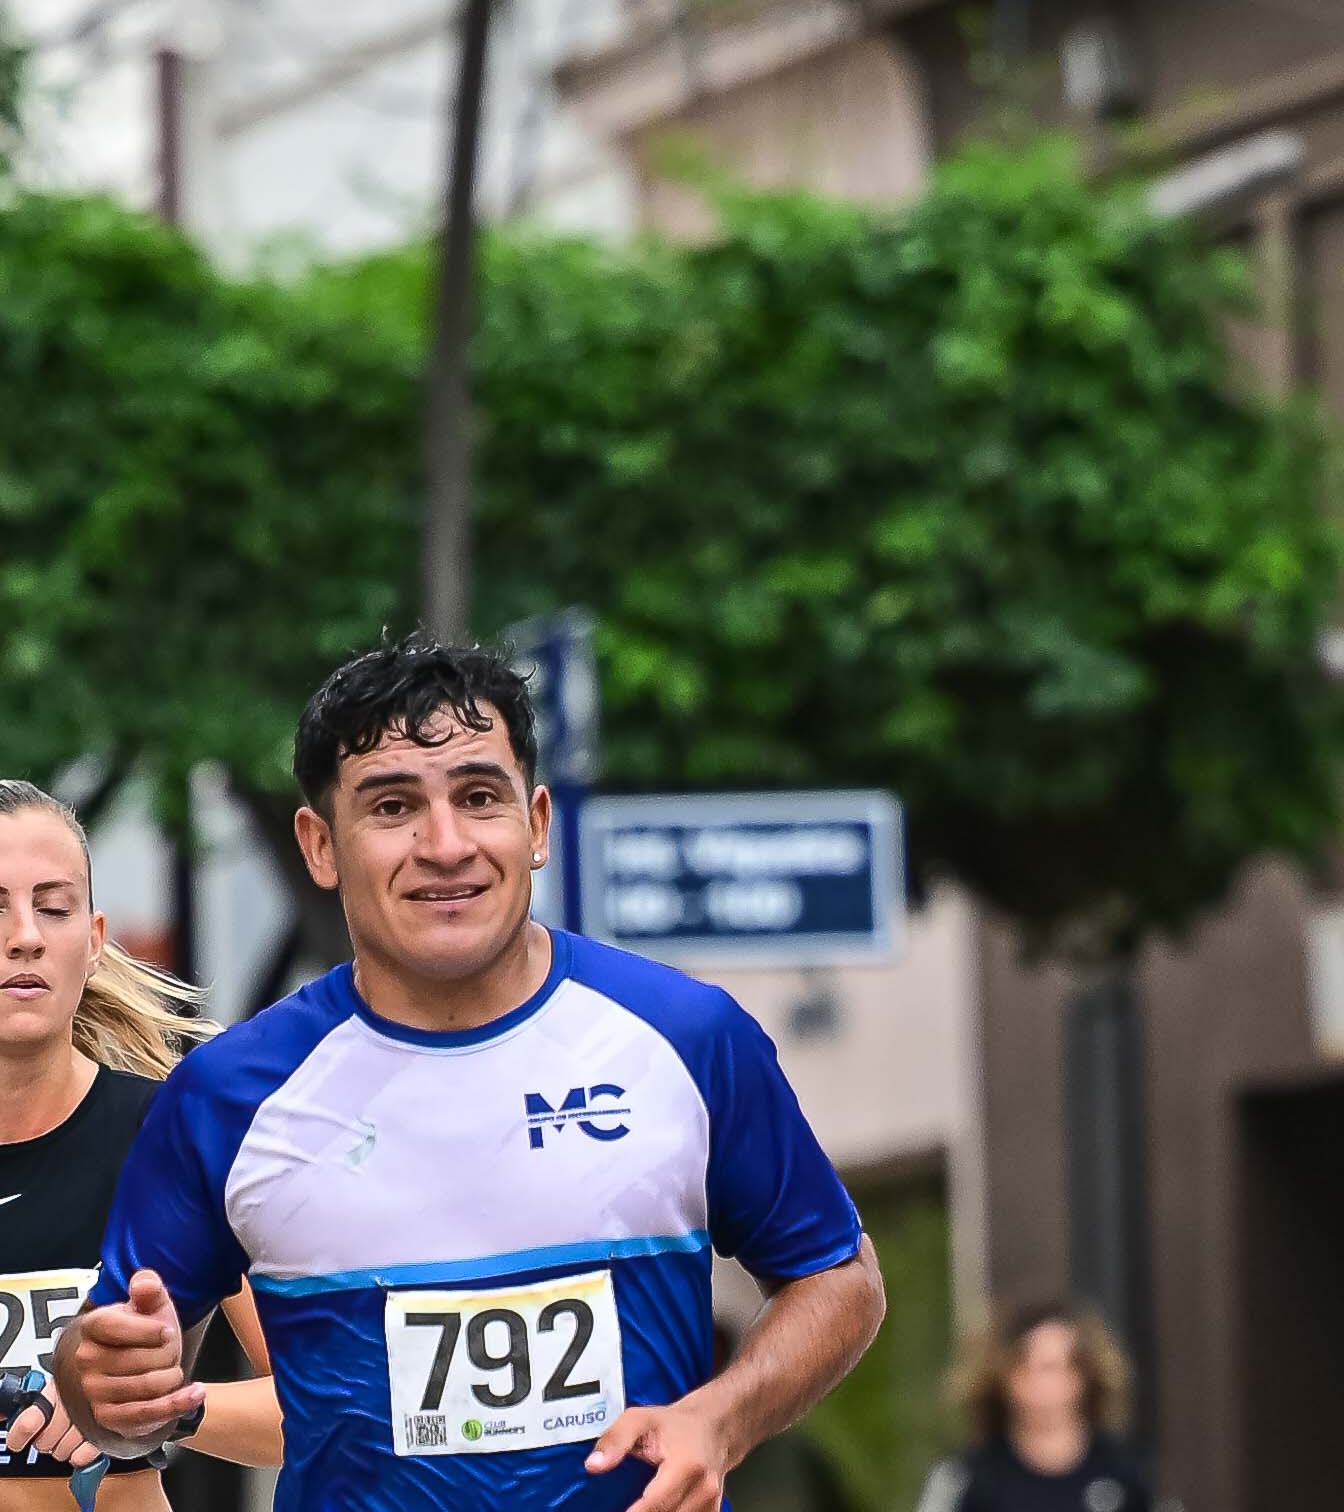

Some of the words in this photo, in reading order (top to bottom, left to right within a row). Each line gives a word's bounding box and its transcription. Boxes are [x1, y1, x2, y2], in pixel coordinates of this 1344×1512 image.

[523, 1083, 631, 1150] MC
[404, 1298, 601, 1411] 792
[543, 1409, 606, 1431] CARUSO
